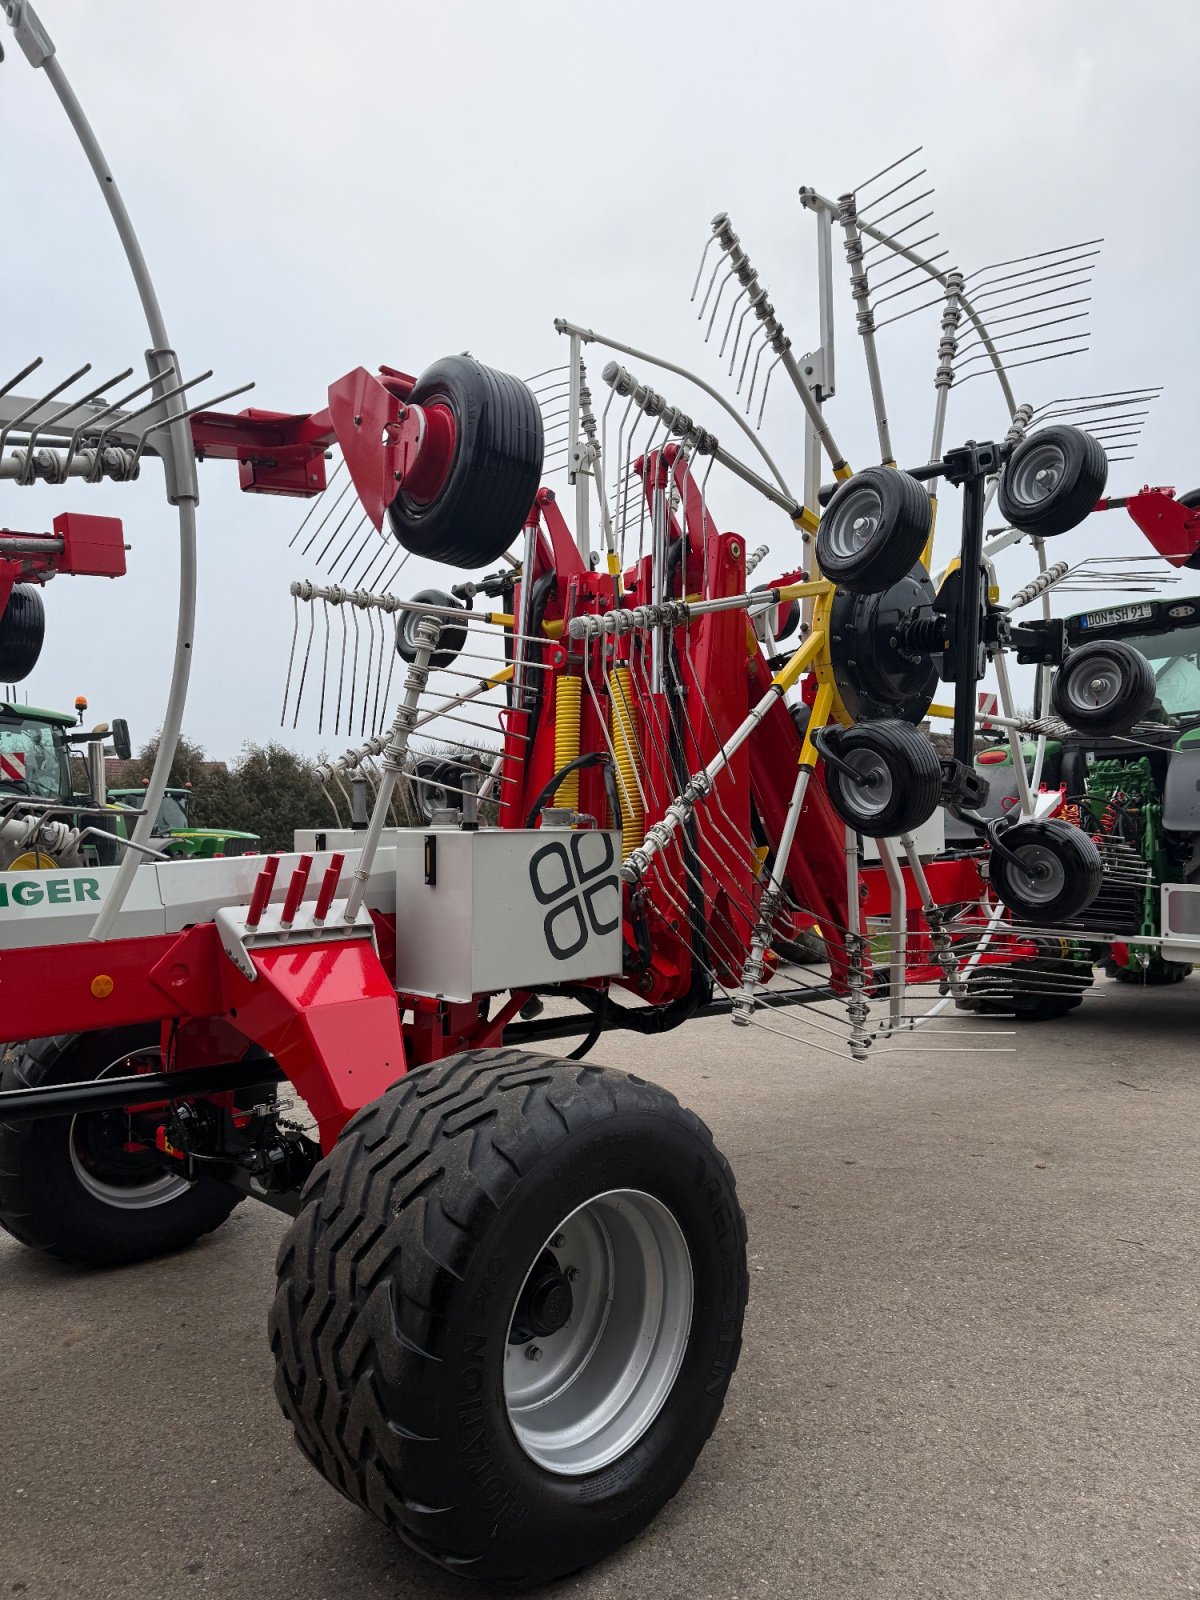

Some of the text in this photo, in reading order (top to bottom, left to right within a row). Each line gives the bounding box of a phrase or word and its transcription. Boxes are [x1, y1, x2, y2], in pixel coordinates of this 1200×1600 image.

[1087, 606, 1144, 626] DON SH 91
